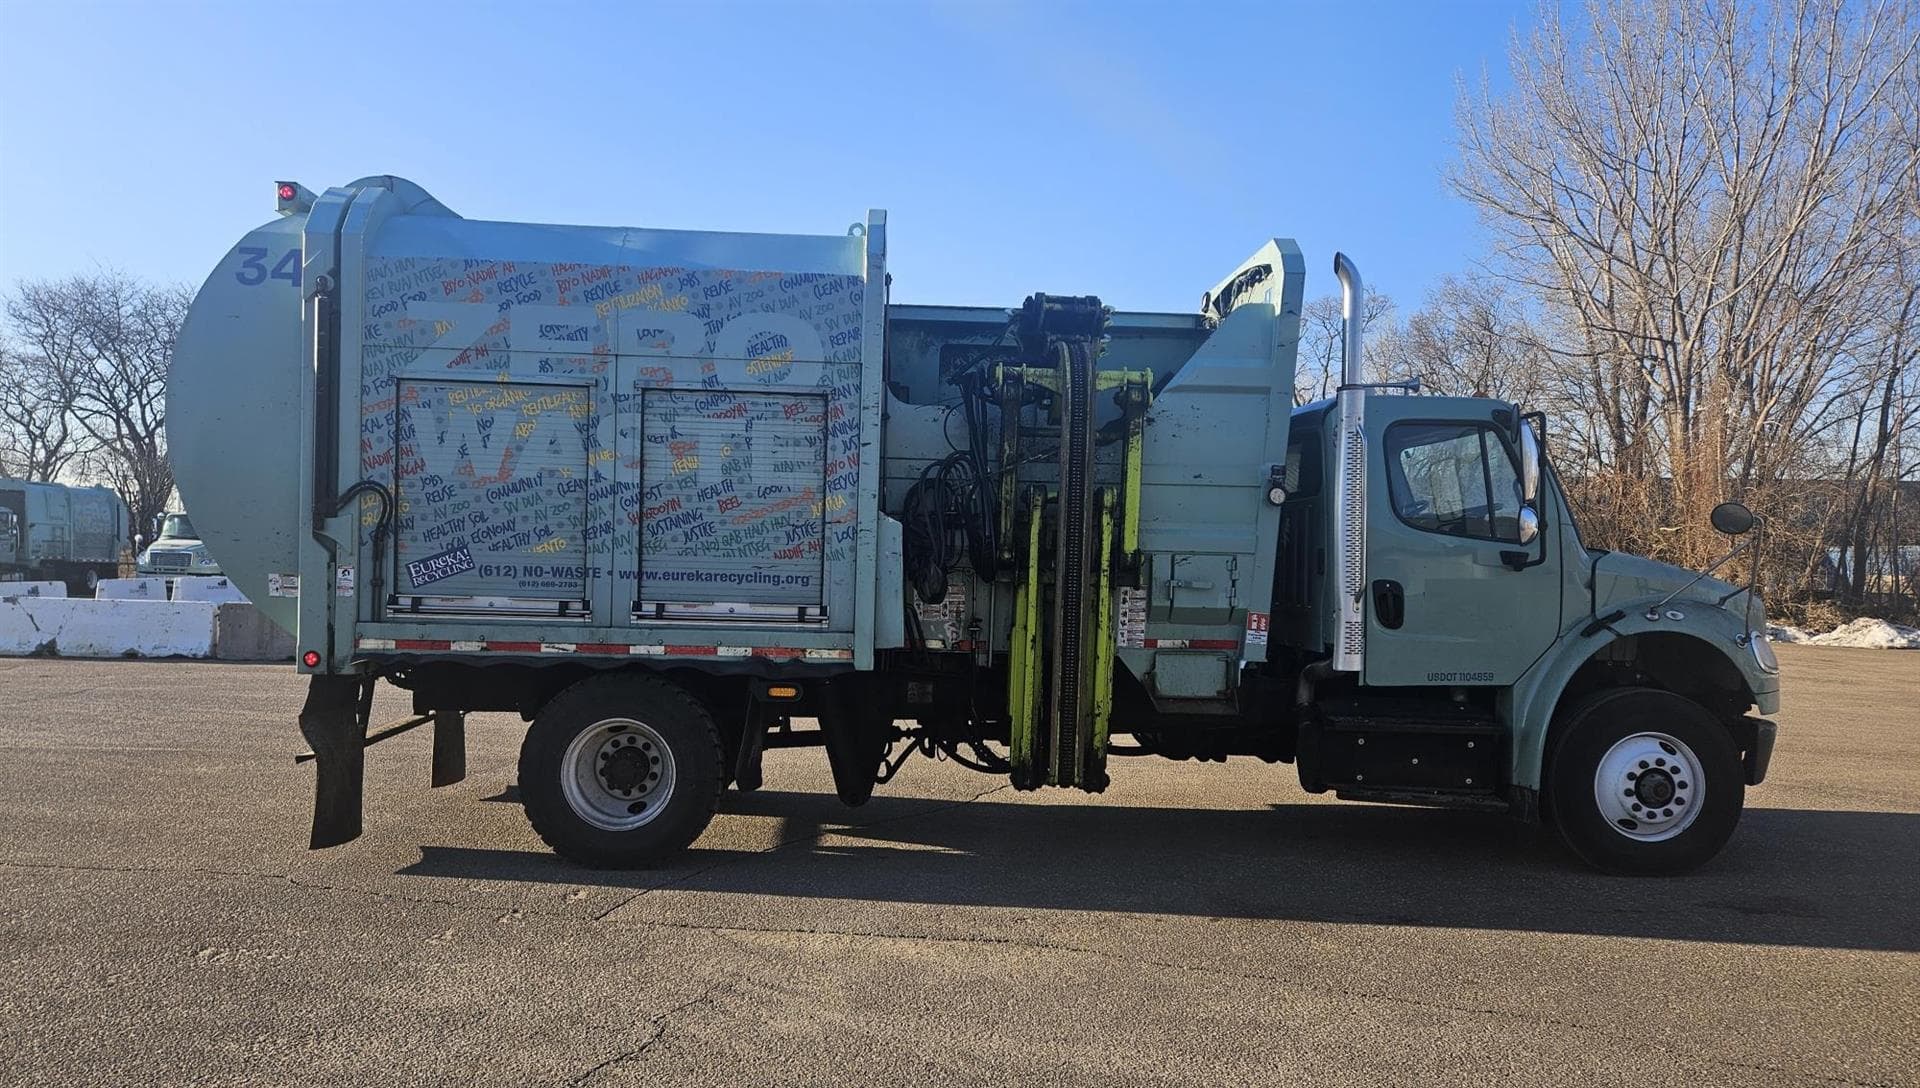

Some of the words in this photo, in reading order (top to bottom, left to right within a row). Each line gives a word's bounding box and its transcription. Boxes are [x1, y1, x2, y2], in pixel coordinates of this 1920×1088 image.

[235, 247, 302, 287] 34
[497, 271, 537, 296] RECYCLE
[583, 279, 623, 303] RECYCLE
[515, 289, 542, 305] FOOD
[371, 300, 399, 319] GOOD
[486, 473, 543, 504] COMMUNITY
[422, 516, 467, 543] HEALTHY
[412, 559, 473, 586] RECYCLING
[478, 564, 517, 580] (612)
[523, 565, 602, 580] NO-WASTE
[618, 569, 811, 588] www.eurekarecycling.org
[519, 580, 539, 589] (612)
[1427, 671, 1457, 682] USDOT
